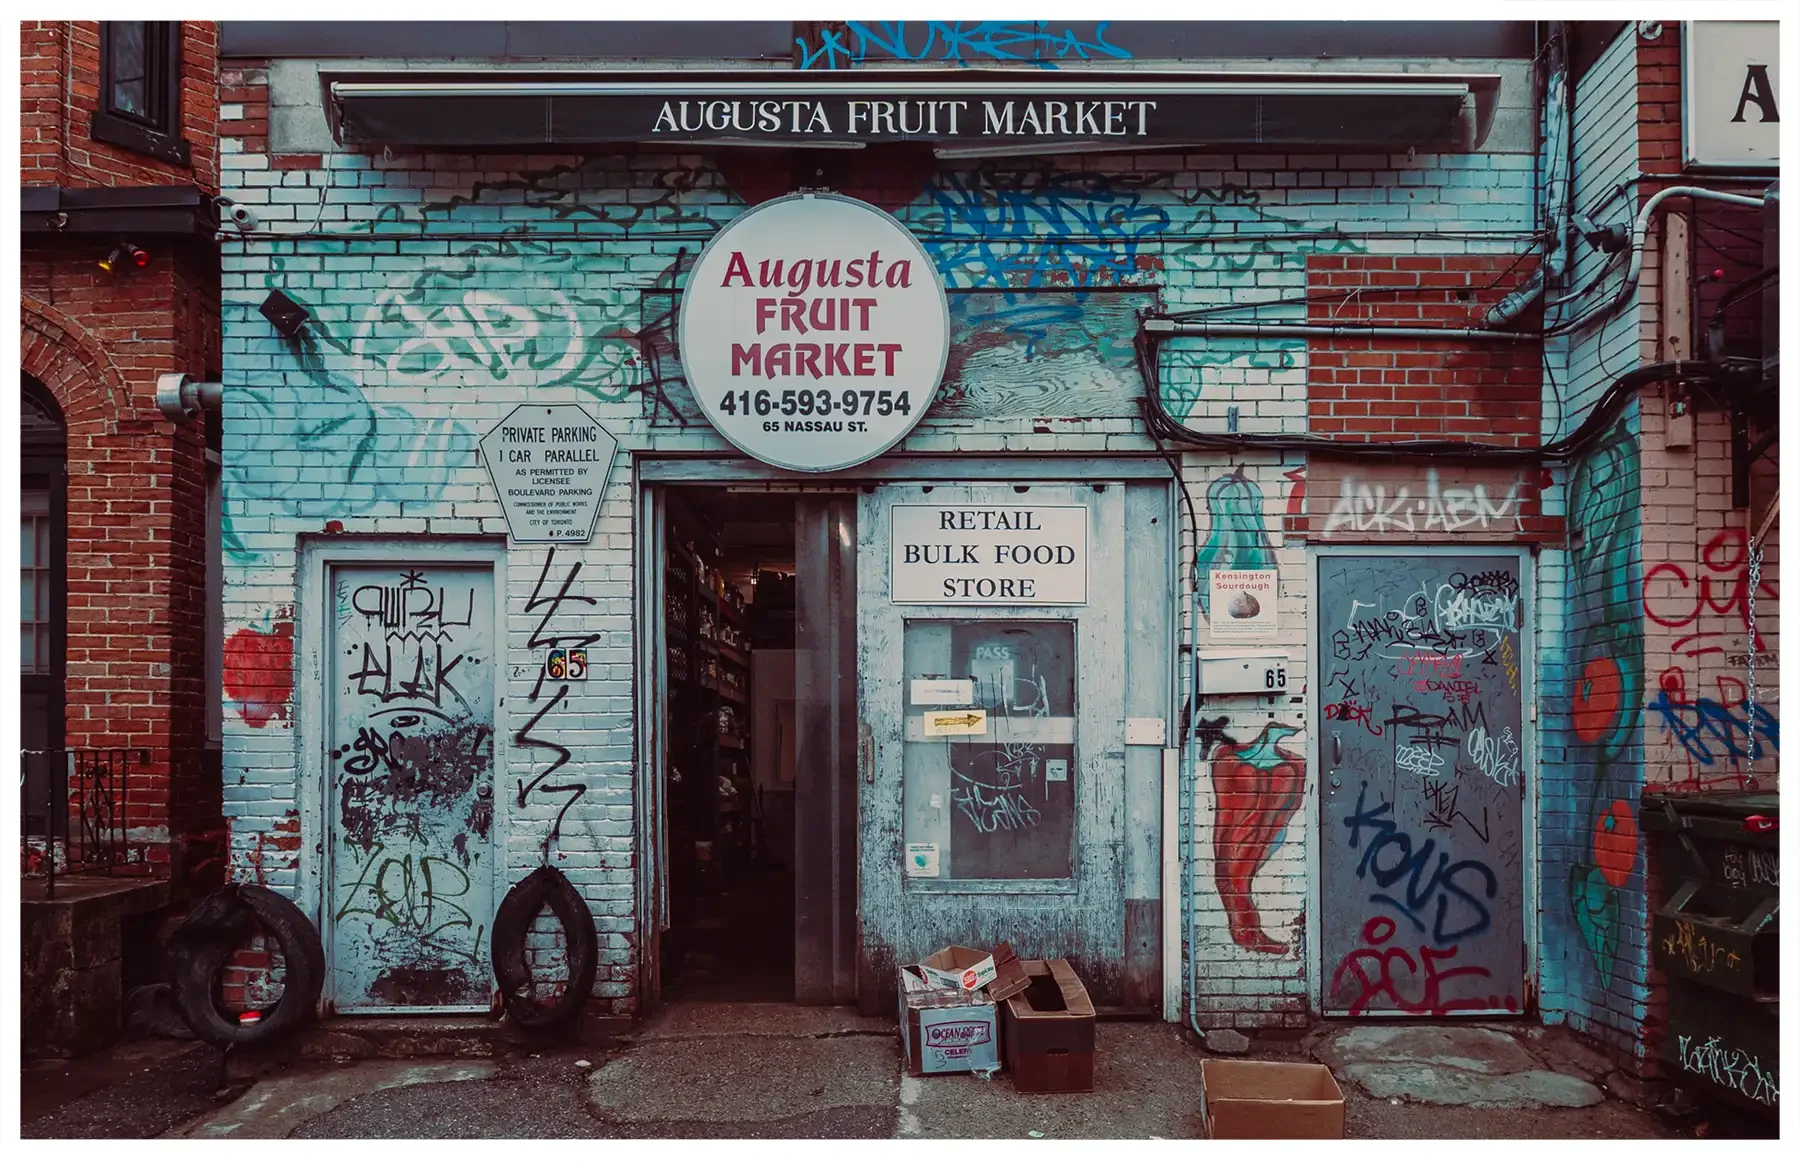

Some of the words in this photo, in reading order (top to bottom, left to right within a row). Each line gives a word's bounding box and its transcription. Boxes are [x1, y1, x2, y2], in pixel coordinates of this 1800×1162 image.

[1731, 64, 1780, 123] A
[652, 101, 833, 133] AUGUSTA
[847, 101, 967, 135] FRUIT
[982, 101, 1156, 136] MARKET
[720, 250, 912, 297] Augusta
[755, 298, 878, 335] FRUIT
[731, 343, 903, 380] MARKET
[719, 389, 911, 416] 416-593-9754
[502, 427, 546, 443] PRIVATE
[551, 426, 597, 443] PARKING
[762, 421, 780, 432] 65
[784, 421, 843, 432] NASSAU
[847, 421, 868, 432] ST.
[509, 450, 532, 462] CAR
[545, 449, 599, 462] PARALLEL
[530, 468, 575, 476] PERMITTED
[559, 488, 593, 496] PARKING
[938, 510, 1042, 531] RETAIL
[903, 544, 980, 564] BULK
[994, 544, 1076, 565] FOOD
[1215, 572, 1271, 581] Kensington
[943, 578, 1036, 598] STORE
[1216, 582, 1270, 591] Sourdough
[976, 647, 1010, 660] PASS
[547, 649, 584, 678] 65
[1266, 669, 1286, 688] 65
[932, 1027, 960, 1039] OCEAN
